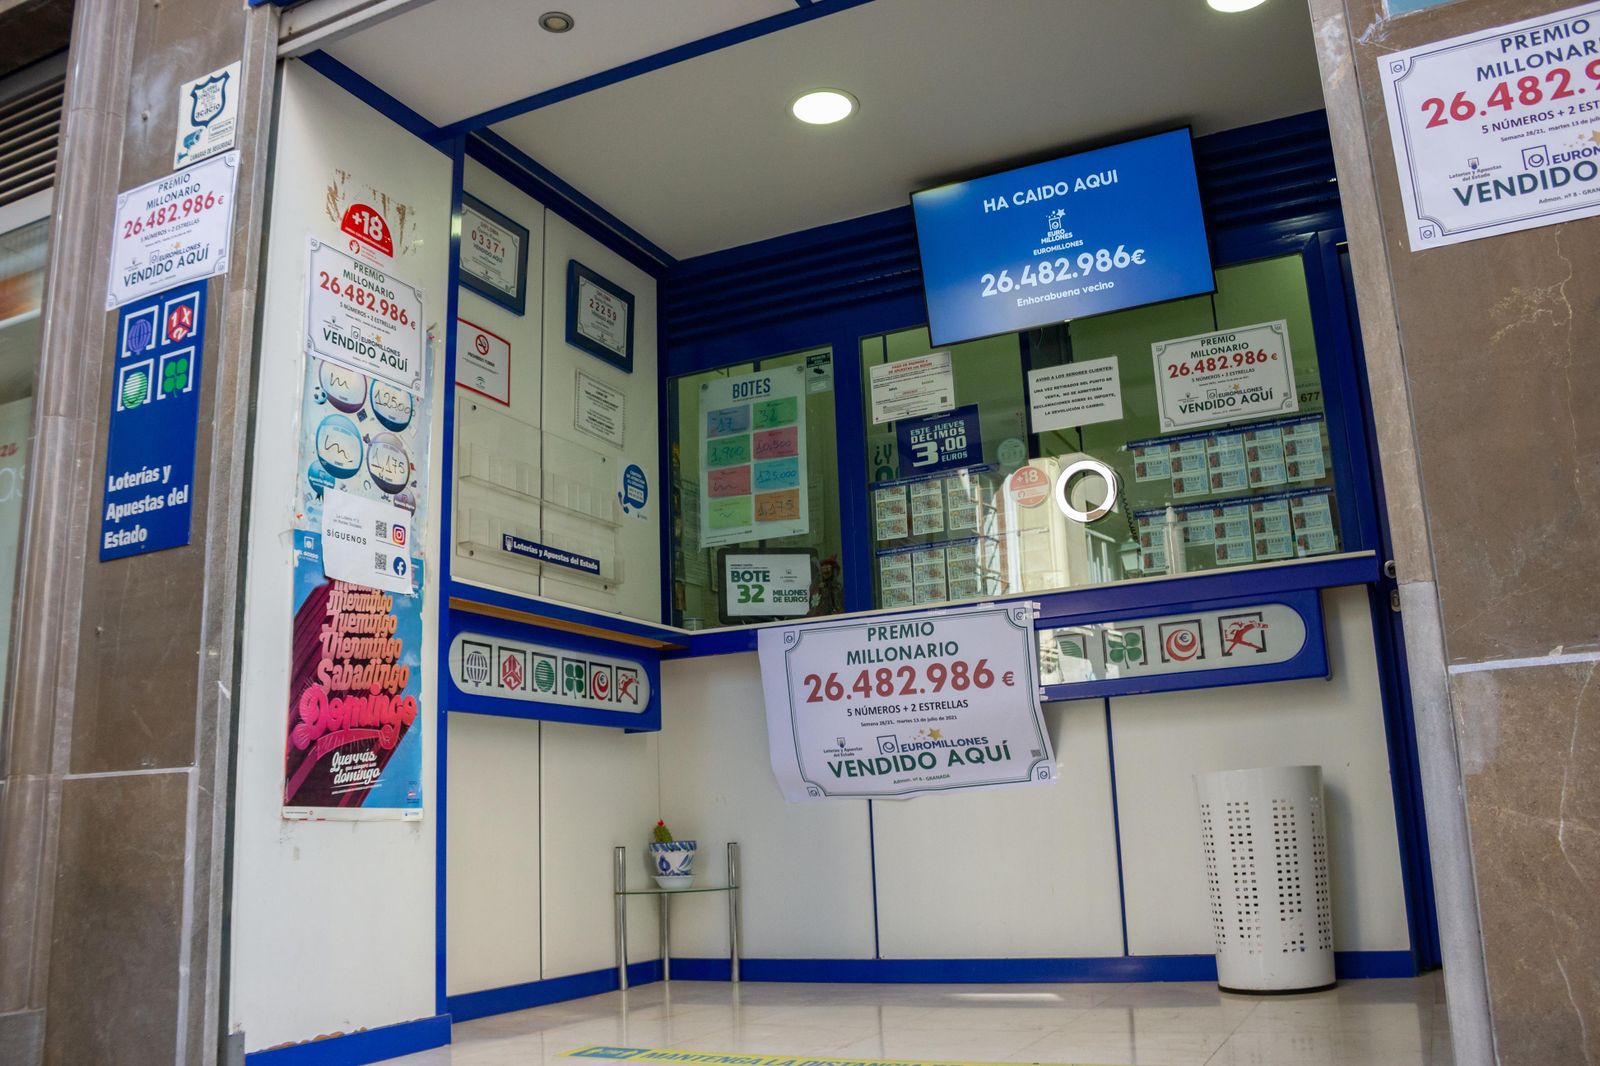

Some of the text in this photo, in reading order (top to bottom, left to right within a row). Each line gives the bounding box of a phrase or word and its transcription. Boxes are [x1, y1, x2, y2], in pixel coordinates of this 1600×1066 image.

[1500, 18, 1590, 54] PREMIO
[1476, 37, 1600, 82] MILLONAR
[1481, 105, 1576, 135] 5 NÚMEROS + 2
[1500, 133, 1525, 142] Semana
[1548, 123, 1570, 132] martes
[158, 173, 191, 193] PREMIO
[983, 169, 1119, 214] HA CAIDO AQUI
[1453, 160, 1598, 207] VENDIDO
[146, 183, 201, 210] MILLONARIO
[124, 190, 215, 239] 26.482.986
[217, 195, 225, 205] €
[352, 211, 383, 241] +18
[1047, 228, 1066, 238] EURO
[1032, 239, 1084, 256] EUROMILLONES
[1040, 231, 1073, 245] MILLONES
[159, 242, 201, 262] EUROMILLONES
[124, 260, 173, 288] VENDIDO
[176, 243, 210, 269] AQUÍ
[354, 261, 386, 284] PREMIO
[980, 244, 1147, 299] 26.482.986€
[343, 269, 395, 300] MILLONARIO
[1016, 280, 1115, 308] Enhorabuena vecino
[319, 271, 408, 326] 26.482.986
[410, 320, 416, 330] €
[323, 327, 376, 359] VENDIDO
[380, 352, 408, 372] AQUÍ
[361, 336, 401, 357] EUROMILLONES
[1190, 342, 1249, 359] MILLONARIO
[1200, 334, 1236, 347] PREMIO
[1168, 349, 1278, 379] 26.482.986 €
[1195, 373, 1221, 382] NÚMEROS
[1229, 367, 1255, 377] ESTRELLAS
[732, 377, 771, 399] BOTES
[1218, 386, 1263, 398] EUROMILLONES
[1179, 396, 1236, 414] VENDIDO
[1240, 387, 1273, 405] AQUÍ
[910, 420, 965, 436] ESTE JUEVES
[910, 426, 966, 444] DECIMOS
[911, 435, 967, 468] 3,00
[941, 450, 968, 463] EUROS
[108, 464, 172, 493] Loterías y
[105, 484, 189, 523] Apuestas del
[103, 524, 148, 550] Estado
[326, 529, 367, 546] SÍGUENOS
[543, 549, 569, 563] Apuestas
[570, 556, 579, 565] del
[579, 560, 598, 570] Estado
[730, 570, 771, 583] BOTE
[736, 583, 765, 604] 32
[772, 589, 808, 597] MILLONES
[867, 621, 936, 643] PREMIO
[846, 641, 959, 666] MILLONARIO
[316, 657, 410, 695] Sabadingo
[803, 659, 1016, 704] 26.482.986 €
[292, 683, 418, 750] Domingo
[847, 708, 853, 717] 5
[854, 704, 901, 716] NÚMEROS
[911, 703, 917, 713] 2
[919, 699, 969, 711] ESTRELLAS
[900, 736, 989, 753] EUROMILLONES
[827, 740, 1011, 779] VENDIDO AQUÍ
[333, 767, 381, 785] domingo
[925, 773, 951, 782] GRANADA
[640, 1052, 763, 1065] MANTENGA
